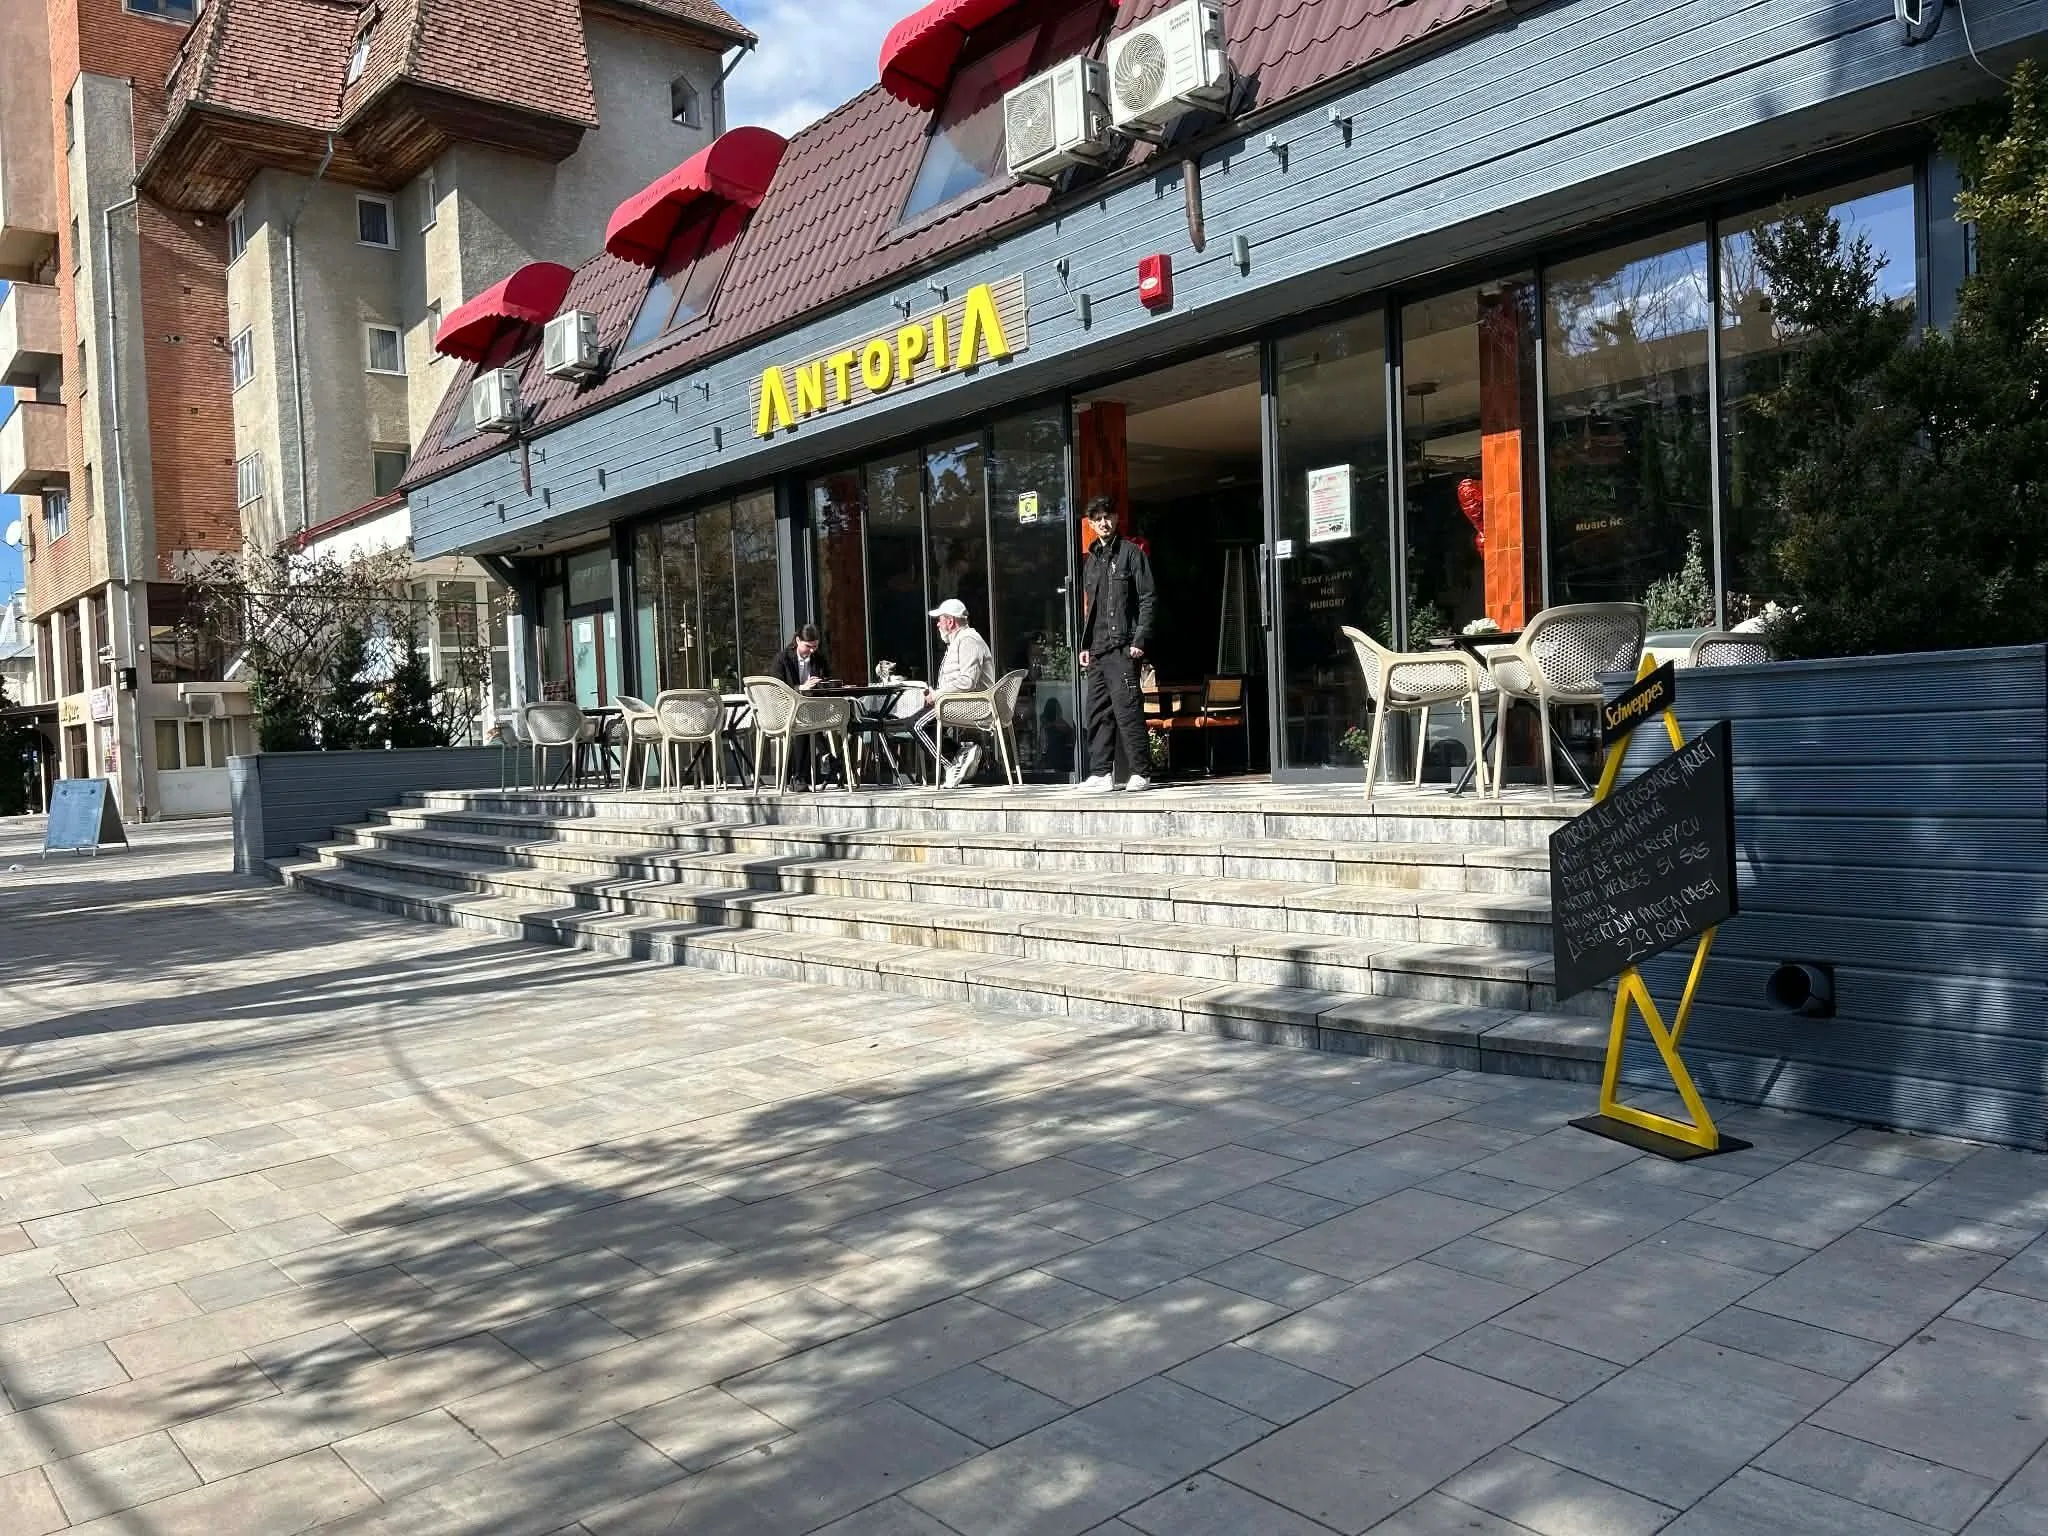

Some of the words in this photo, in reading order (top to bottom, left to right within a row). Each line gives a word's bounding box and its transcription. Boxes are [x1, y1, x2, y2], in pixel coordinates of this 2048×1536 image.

[757, 282, 1011, 437] ANTOPIA
[1605, 680, 1664, 730] Schweppes
[1591, 859, 1612, 881] DE
[1680, 816, 1702, 837] CU
[1655, 908, 1693, 943] RON
